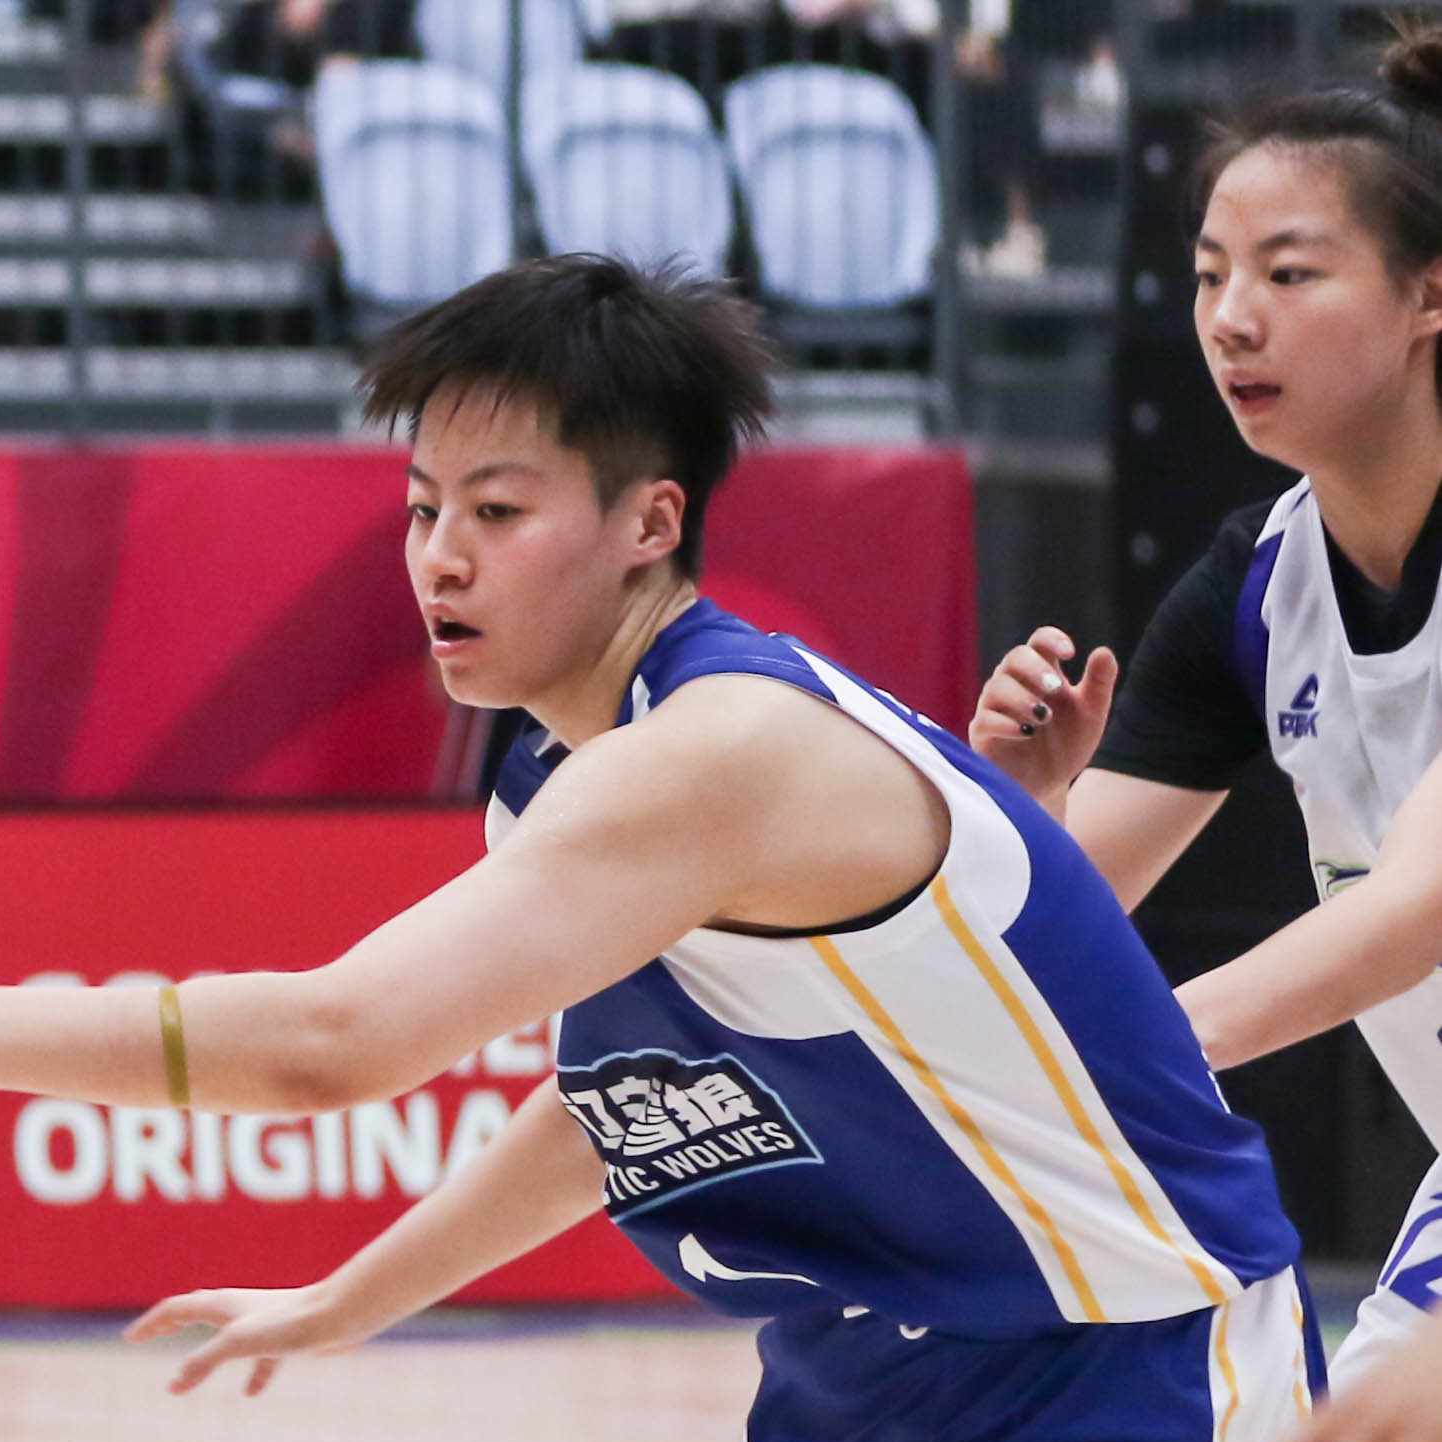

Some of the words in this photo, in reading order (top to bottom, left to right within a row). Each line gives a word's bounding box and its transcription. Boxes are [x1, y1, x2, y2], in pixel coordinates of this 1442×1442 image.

[16, 1088, 514, 1206] ORIGINA
[603, 1161, 660, 1205] TIC
[652, 1121, 795, 1180] WOLVES
